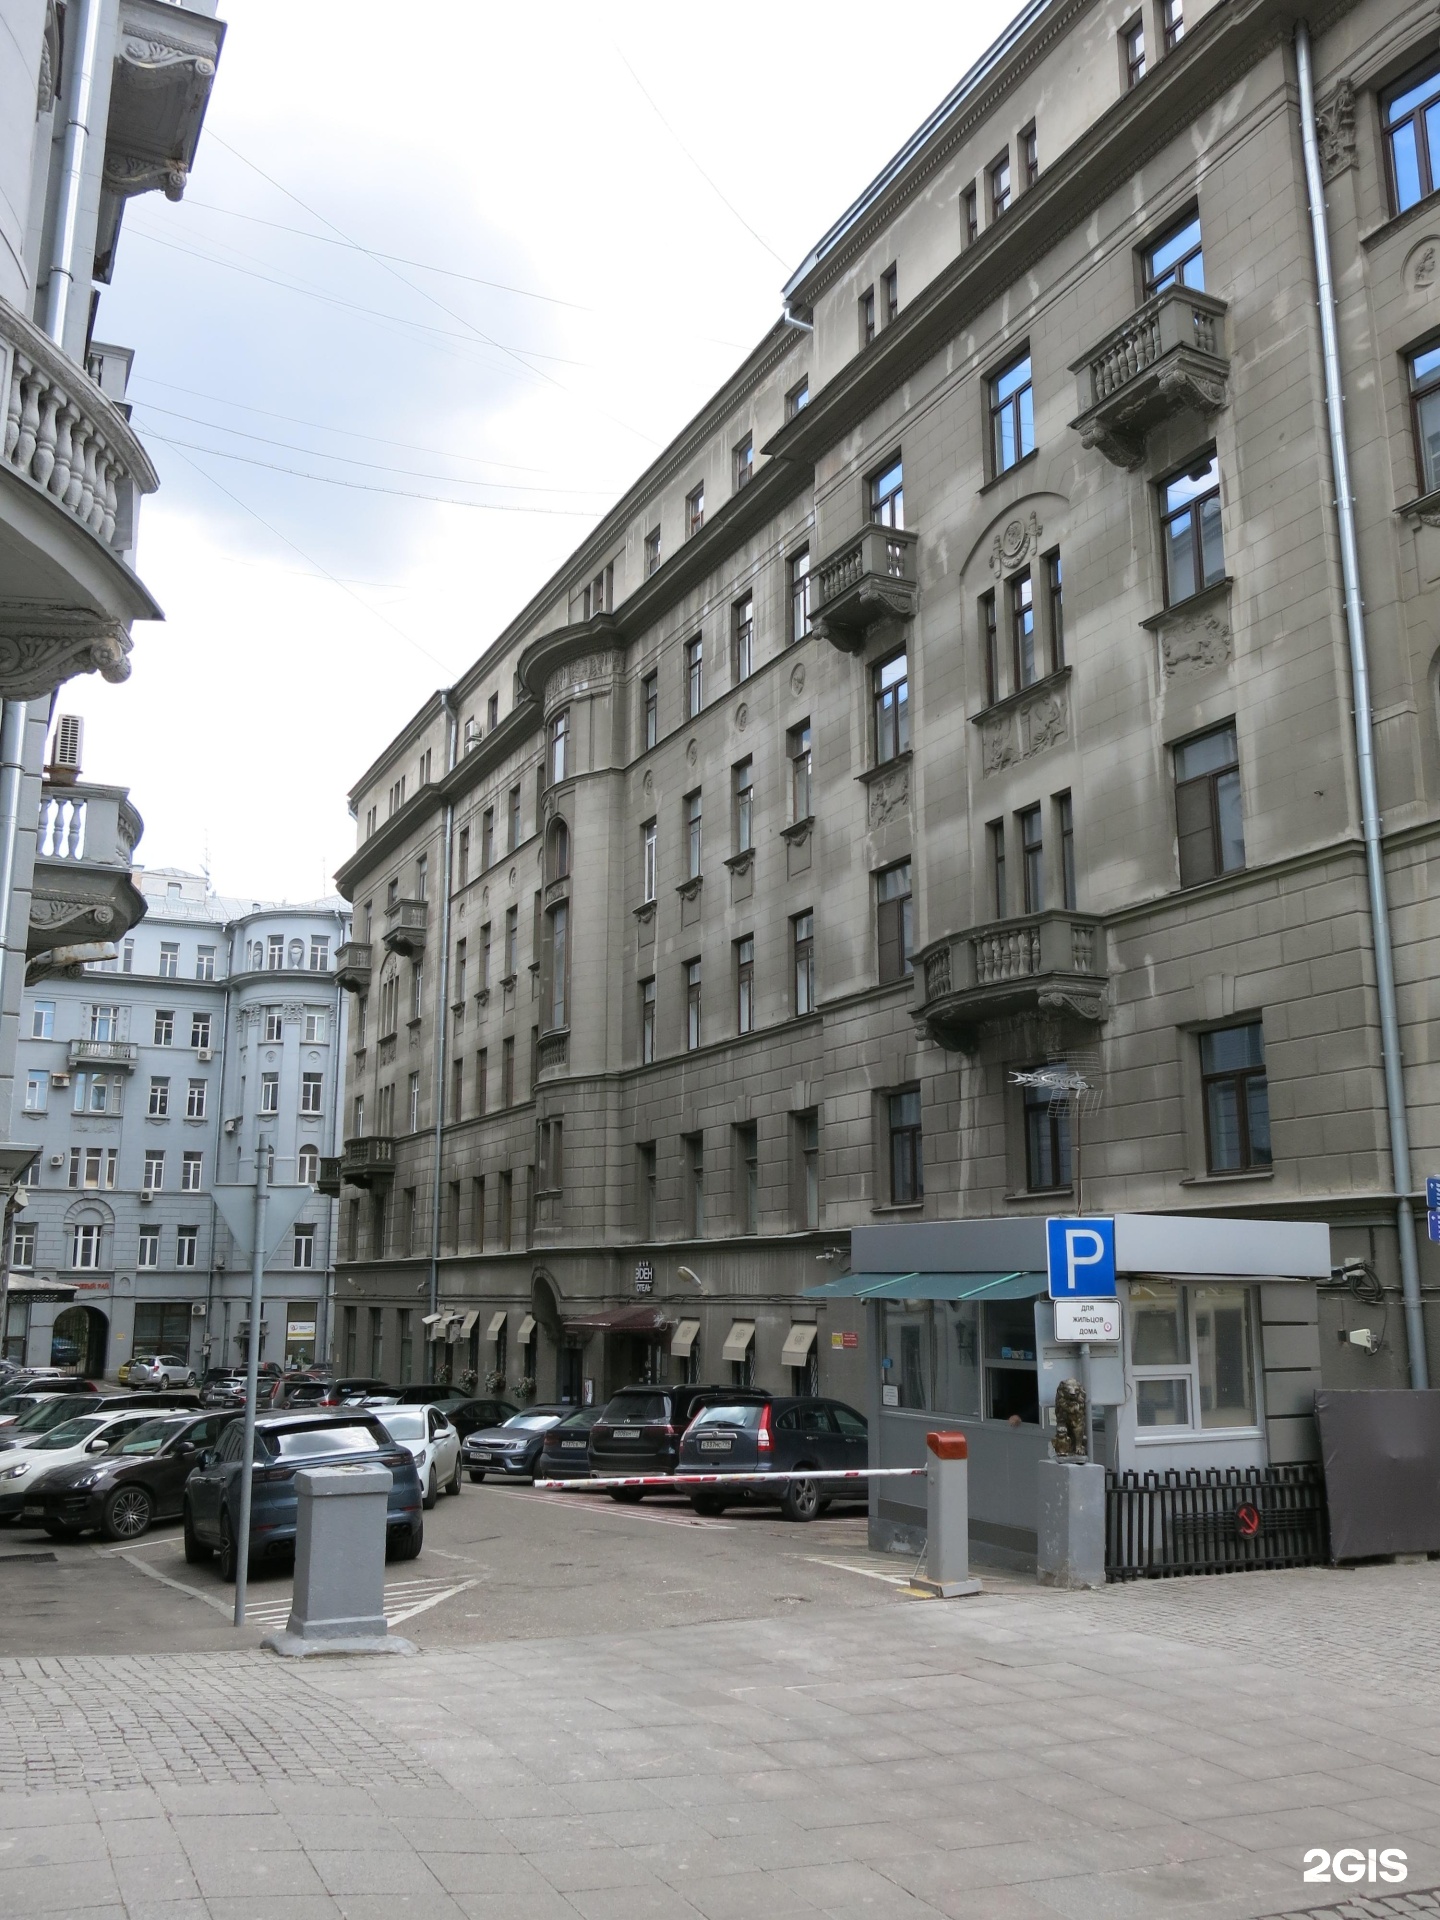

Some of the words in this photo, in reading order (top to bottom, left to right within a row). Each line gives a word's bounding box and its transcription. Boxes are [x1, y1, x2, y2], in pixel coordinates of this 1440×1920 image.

[1065, 1229, 1105, 1289] P
[635, 1267, 653, 1280] ЭДЕН
[636, 1283, 651, 1292] ОТЕЛЬ
[1080, 1304, 1095, 1312] ДЛЯ
[1072, 1316, 1104, 1324] ЖИЛЬЦОВ
